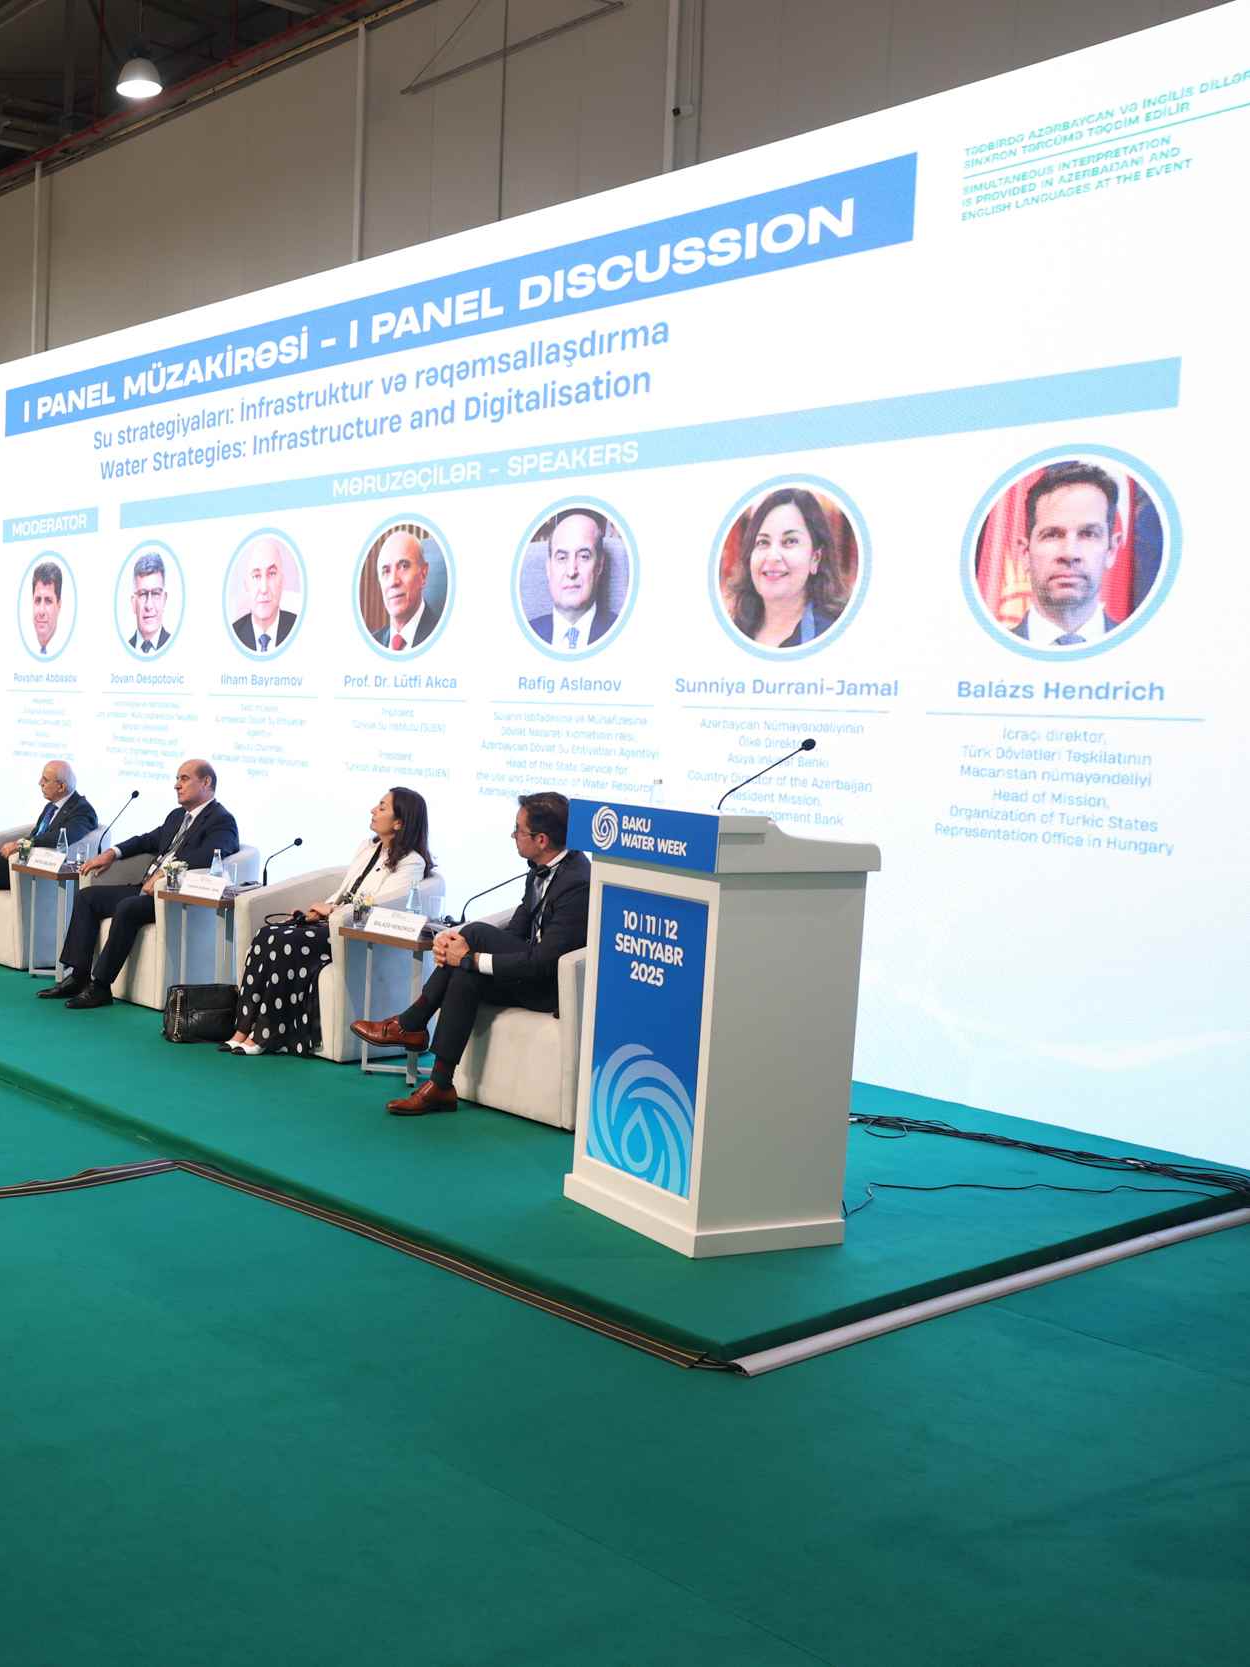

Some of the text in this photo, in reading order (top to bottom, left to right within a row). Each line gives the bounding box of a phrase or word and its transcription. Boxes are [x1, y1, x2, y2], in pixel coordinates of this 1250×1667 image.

[1119, 101, 1139, 115] VƏ
[961, 196, 973, 208] IS
[975, 182, 1037, 206] PROVIDED
[1040, 177, 1053, 189] IN
[1149, 146, 1181, 163] AND
[963, 135, 1171, 195] SIMULTANEOUS INTERPRETATION
[961, 158, 1193, 222] ENGLISH LANGUAGES AT THE EVENT
[22, 400, 30, 423] I
[36, 382, 115, 420] PANEL
[123, 325, 309, 400] MÜZAKİRƏSİ
[349, 319, 358, 348] I
[371, 287, 504, 344] PANEL
[518, 197, 854, 310] DISCUSSION
[93, 320, 670, 450] Su strategiyaları: İnfrastruktur və rəqəmsallaşdırma
[100, 370, 651, 480] Water Strategies: Infrastructure and Digitalisation
[332, 461, 481, 499] MƏRUZƏÇİLƏR
[506, 440, 639, 478] SPEAKERS
[11, 513, 87, 538] MODERATOR
[110, 673, 185, 688] Jovan Despotovic
[251, 674, 303, 689] Bayramov
[344, 674, 371, 688] Prof.
[374, 675, 390, 688] Dr.
[425, 675, 458, 689] Akca
[518, 676, 622, 694] Rafig Aslanov
[675, 677, 900, 697] Sunniya Durrani-Jamal
[957, 677, 1166, 702] Balázs Hendrich
[961, 744, 991, 759] Türk
[1065, 749, 1152, 767] Təşkilatının
[687, 770, 727, 785] Country
[776, 774, 786, 787] of
[790, 774, 808, 788] the
[992, 789, 1028, 804] Head
[1032, 790, 1045, 804] of
[622, 814, 652, 835] BAKU
[814, 812, 844, 826] Bank
[949, 805, 1158, 833] Organization of Turkic States
[620, 834, 687, 857] WATER WEEK
[934, 822, 1174, 857] Representation Office in Hungary
[622, 909, 679, 941] 10 11 12
[614, 932, 685, 968] SENTYABR
[630, 961, 665, 987] 2025
